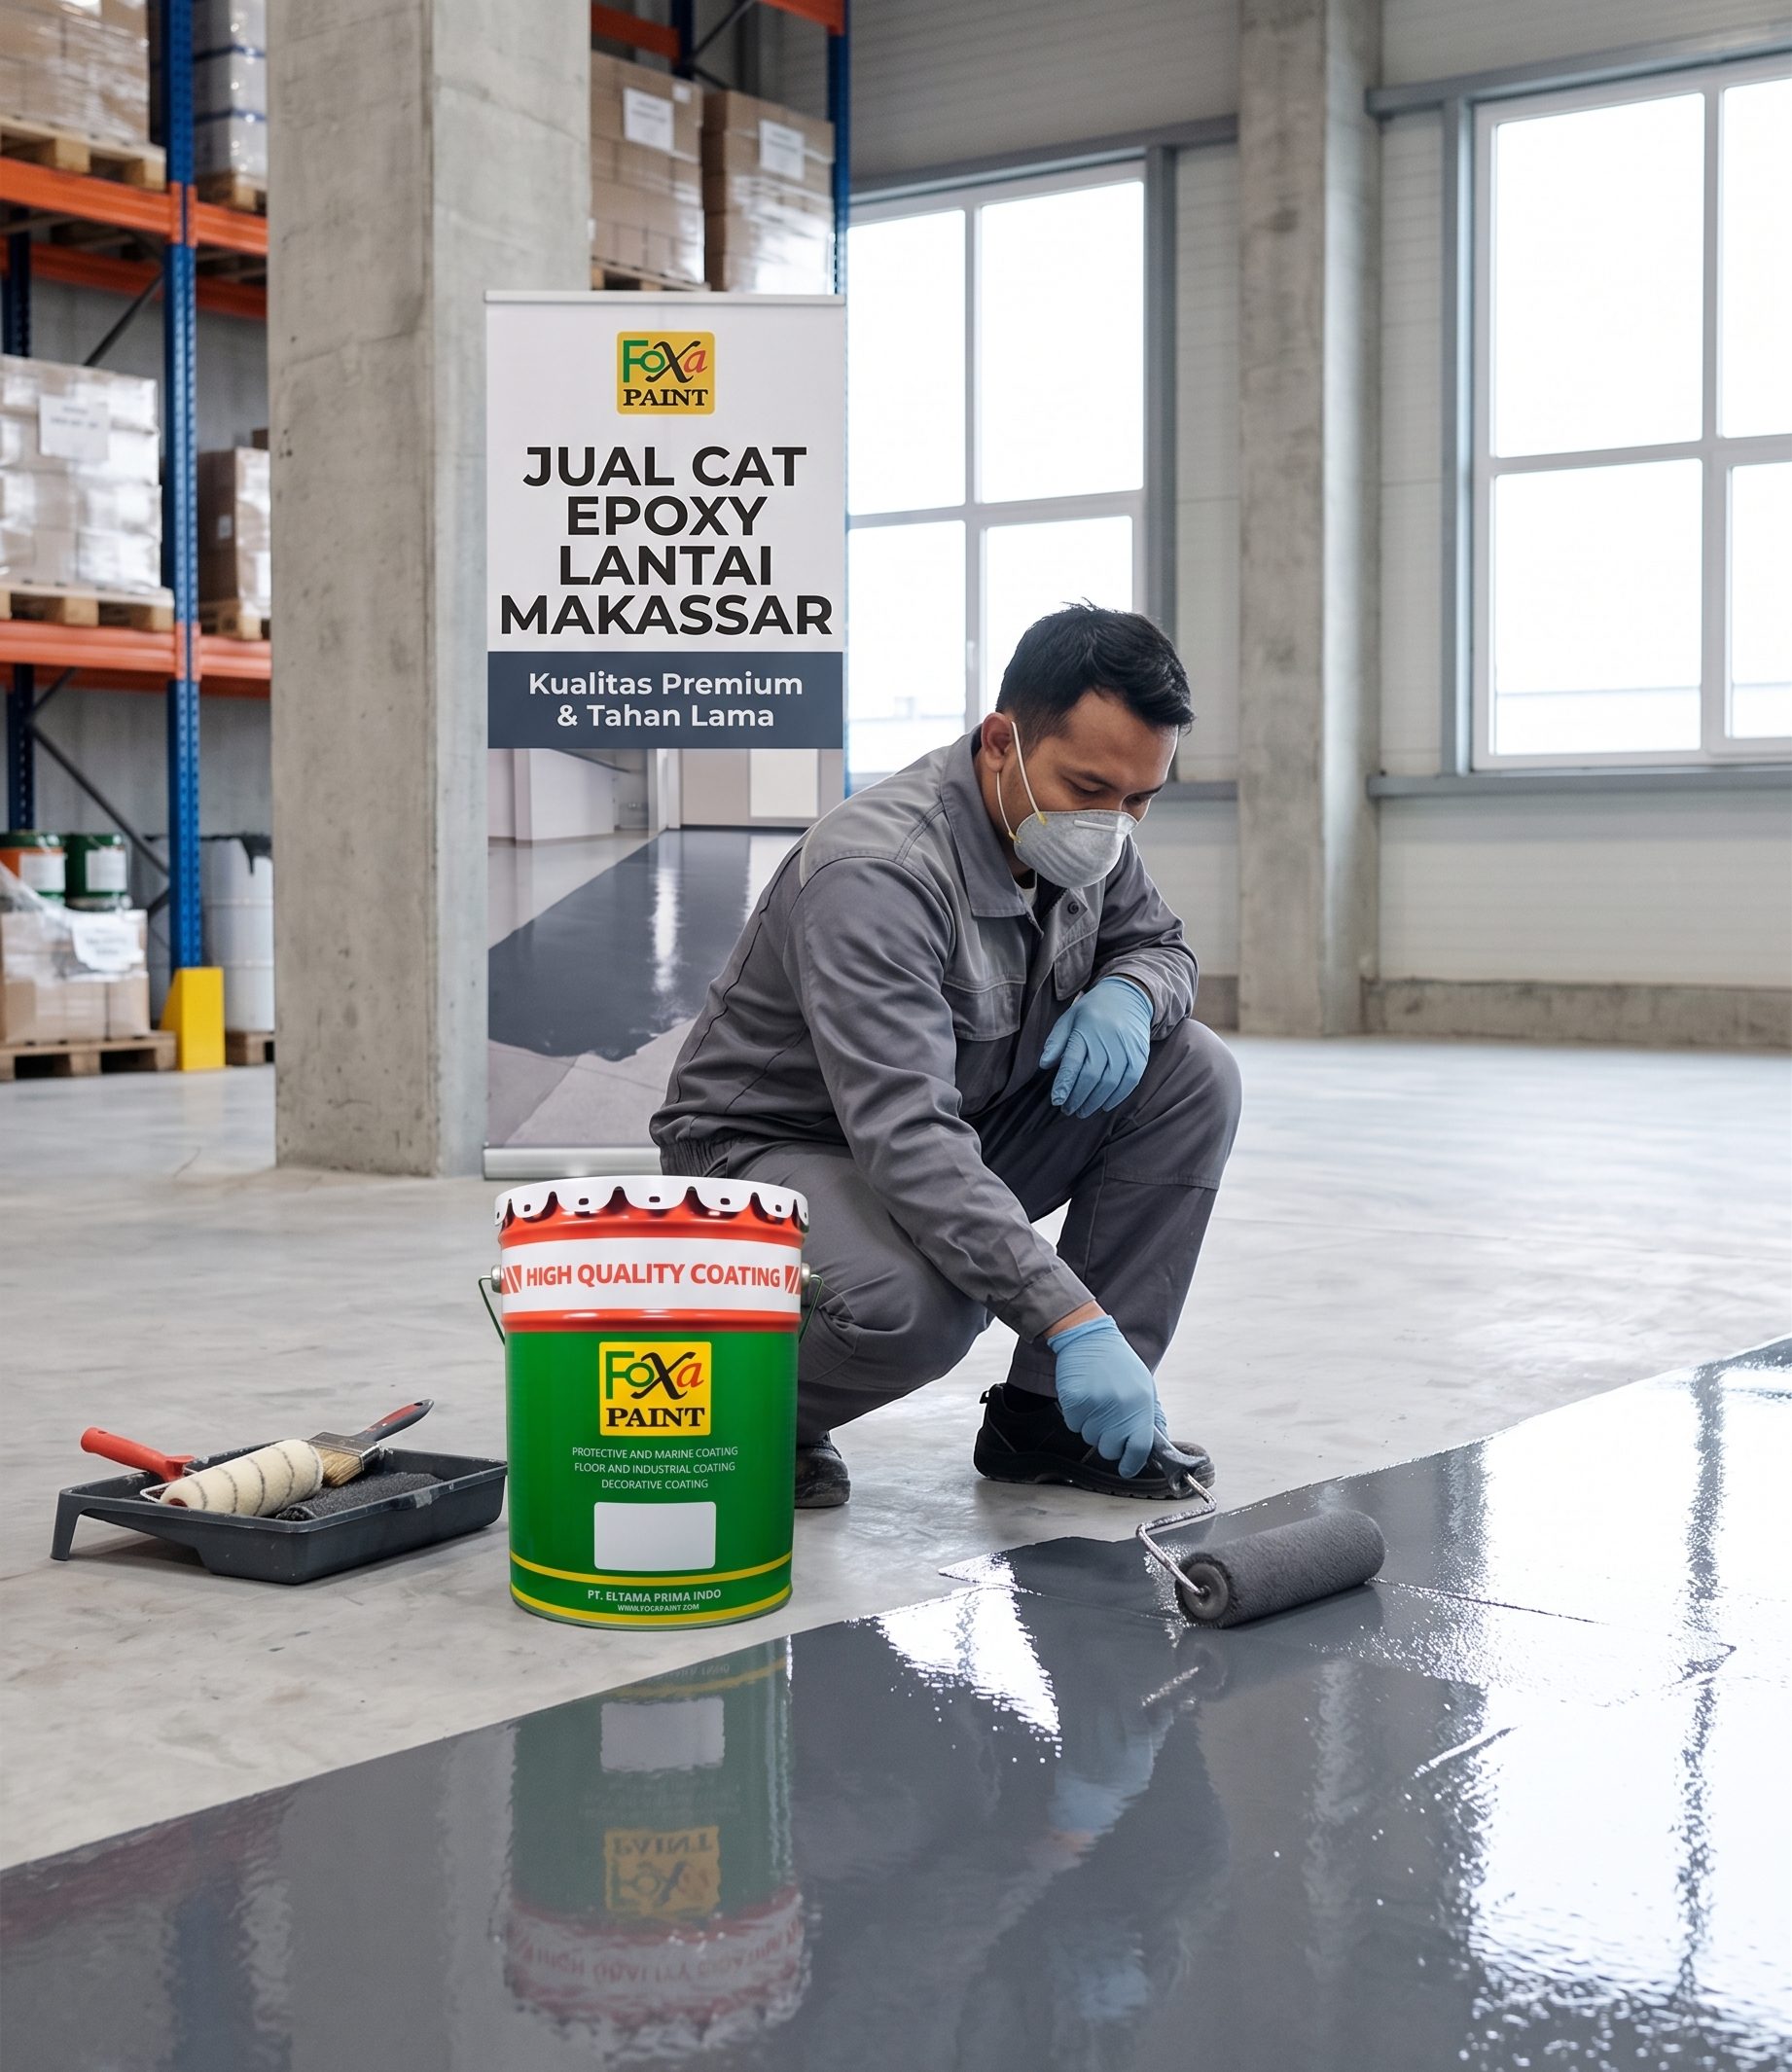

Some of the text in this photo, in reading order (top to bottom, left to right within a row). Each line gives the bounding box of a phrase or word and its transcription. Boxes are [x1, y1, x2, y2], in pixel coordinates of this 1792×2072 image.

[623, 388, 708, 407] PAINT
[523, 447, 807, 487] JUAL CAT
[568, 496, 768, 536] EPOXY
[560, 546, 771, 586] LANTAI
[502, 594, 833, 635] MAKASSAR
[529, 672, 803, 695] Kualitas Premium
[556, 704, 773, 727] & Tahan Lama
[526, 1264, 780, 1287] HIGH QUALITY COATING
[606, 1409, 704, 1427] PAINT
[572, 1447, 737, 1459] PROTECTIVE AND MARINE COATING
[575, 1463, 605, 1472] FLOOR
[633, 1465, 691, 1474] INDUSTRIAL
[694, 1462, 735, 1473] COATING
[602, 1480, 708, 1488] DECORATIVE COATING
[588, 1590, 721, 1602] PT. ELTAMA PRIMA INDO
